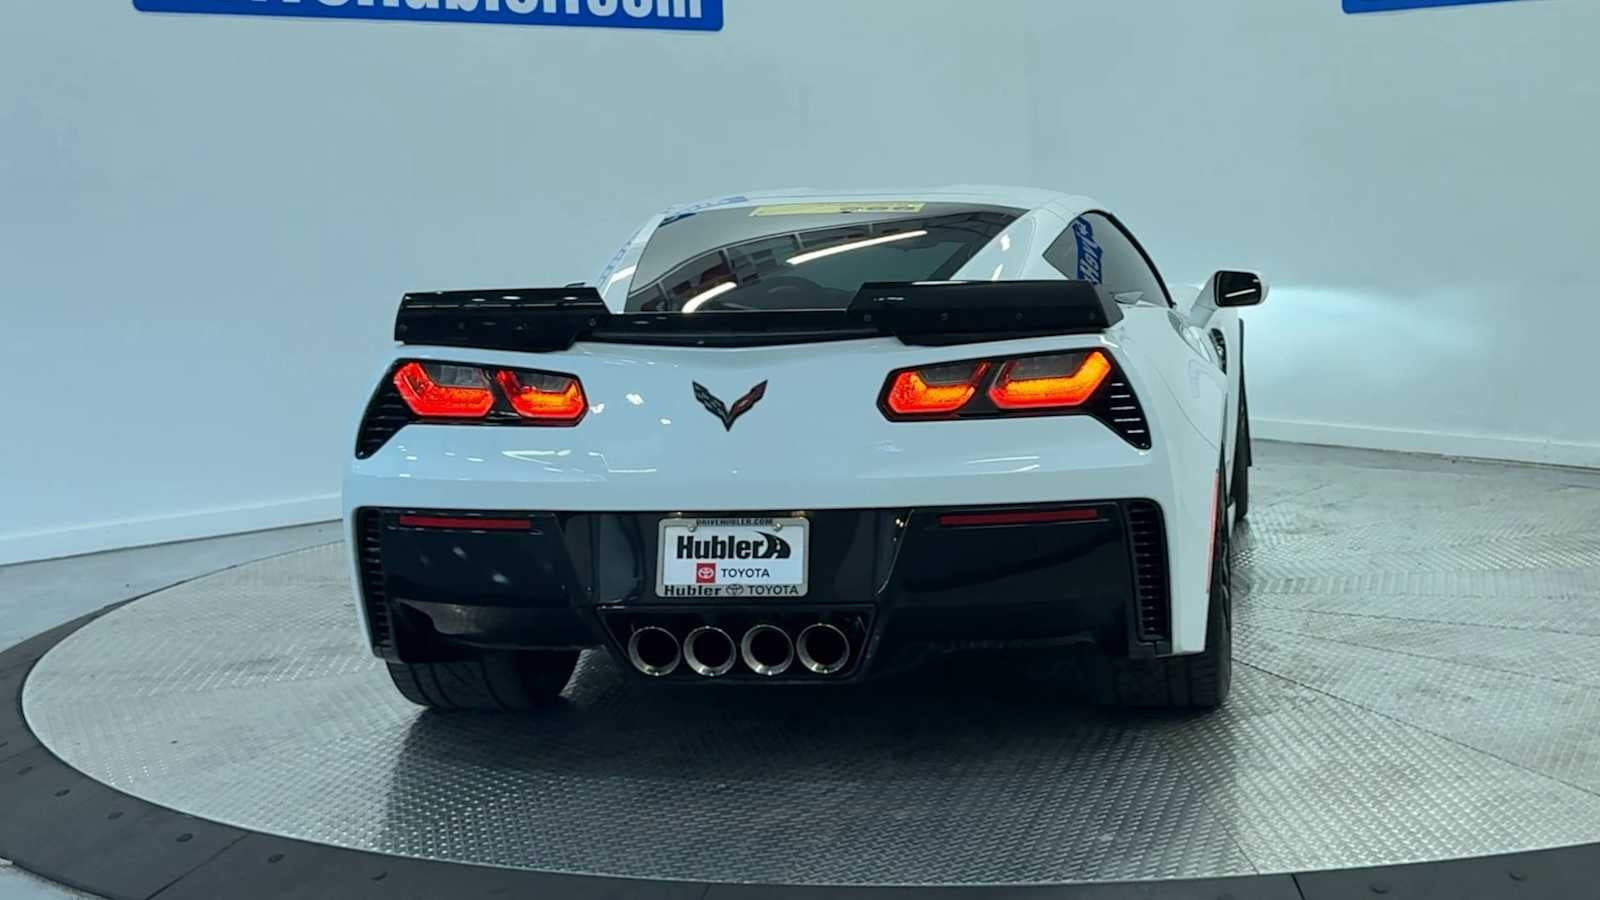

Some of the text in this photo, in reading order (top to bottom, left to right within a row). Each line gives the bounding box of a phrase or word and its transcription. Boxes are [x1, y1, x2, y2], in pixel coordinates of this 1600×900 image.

[677, 535, 764, 560] Hubler
[720, 568, 770, 578] TOYOTA
[664, 585, 799, 597] Hubler TOYOTA
